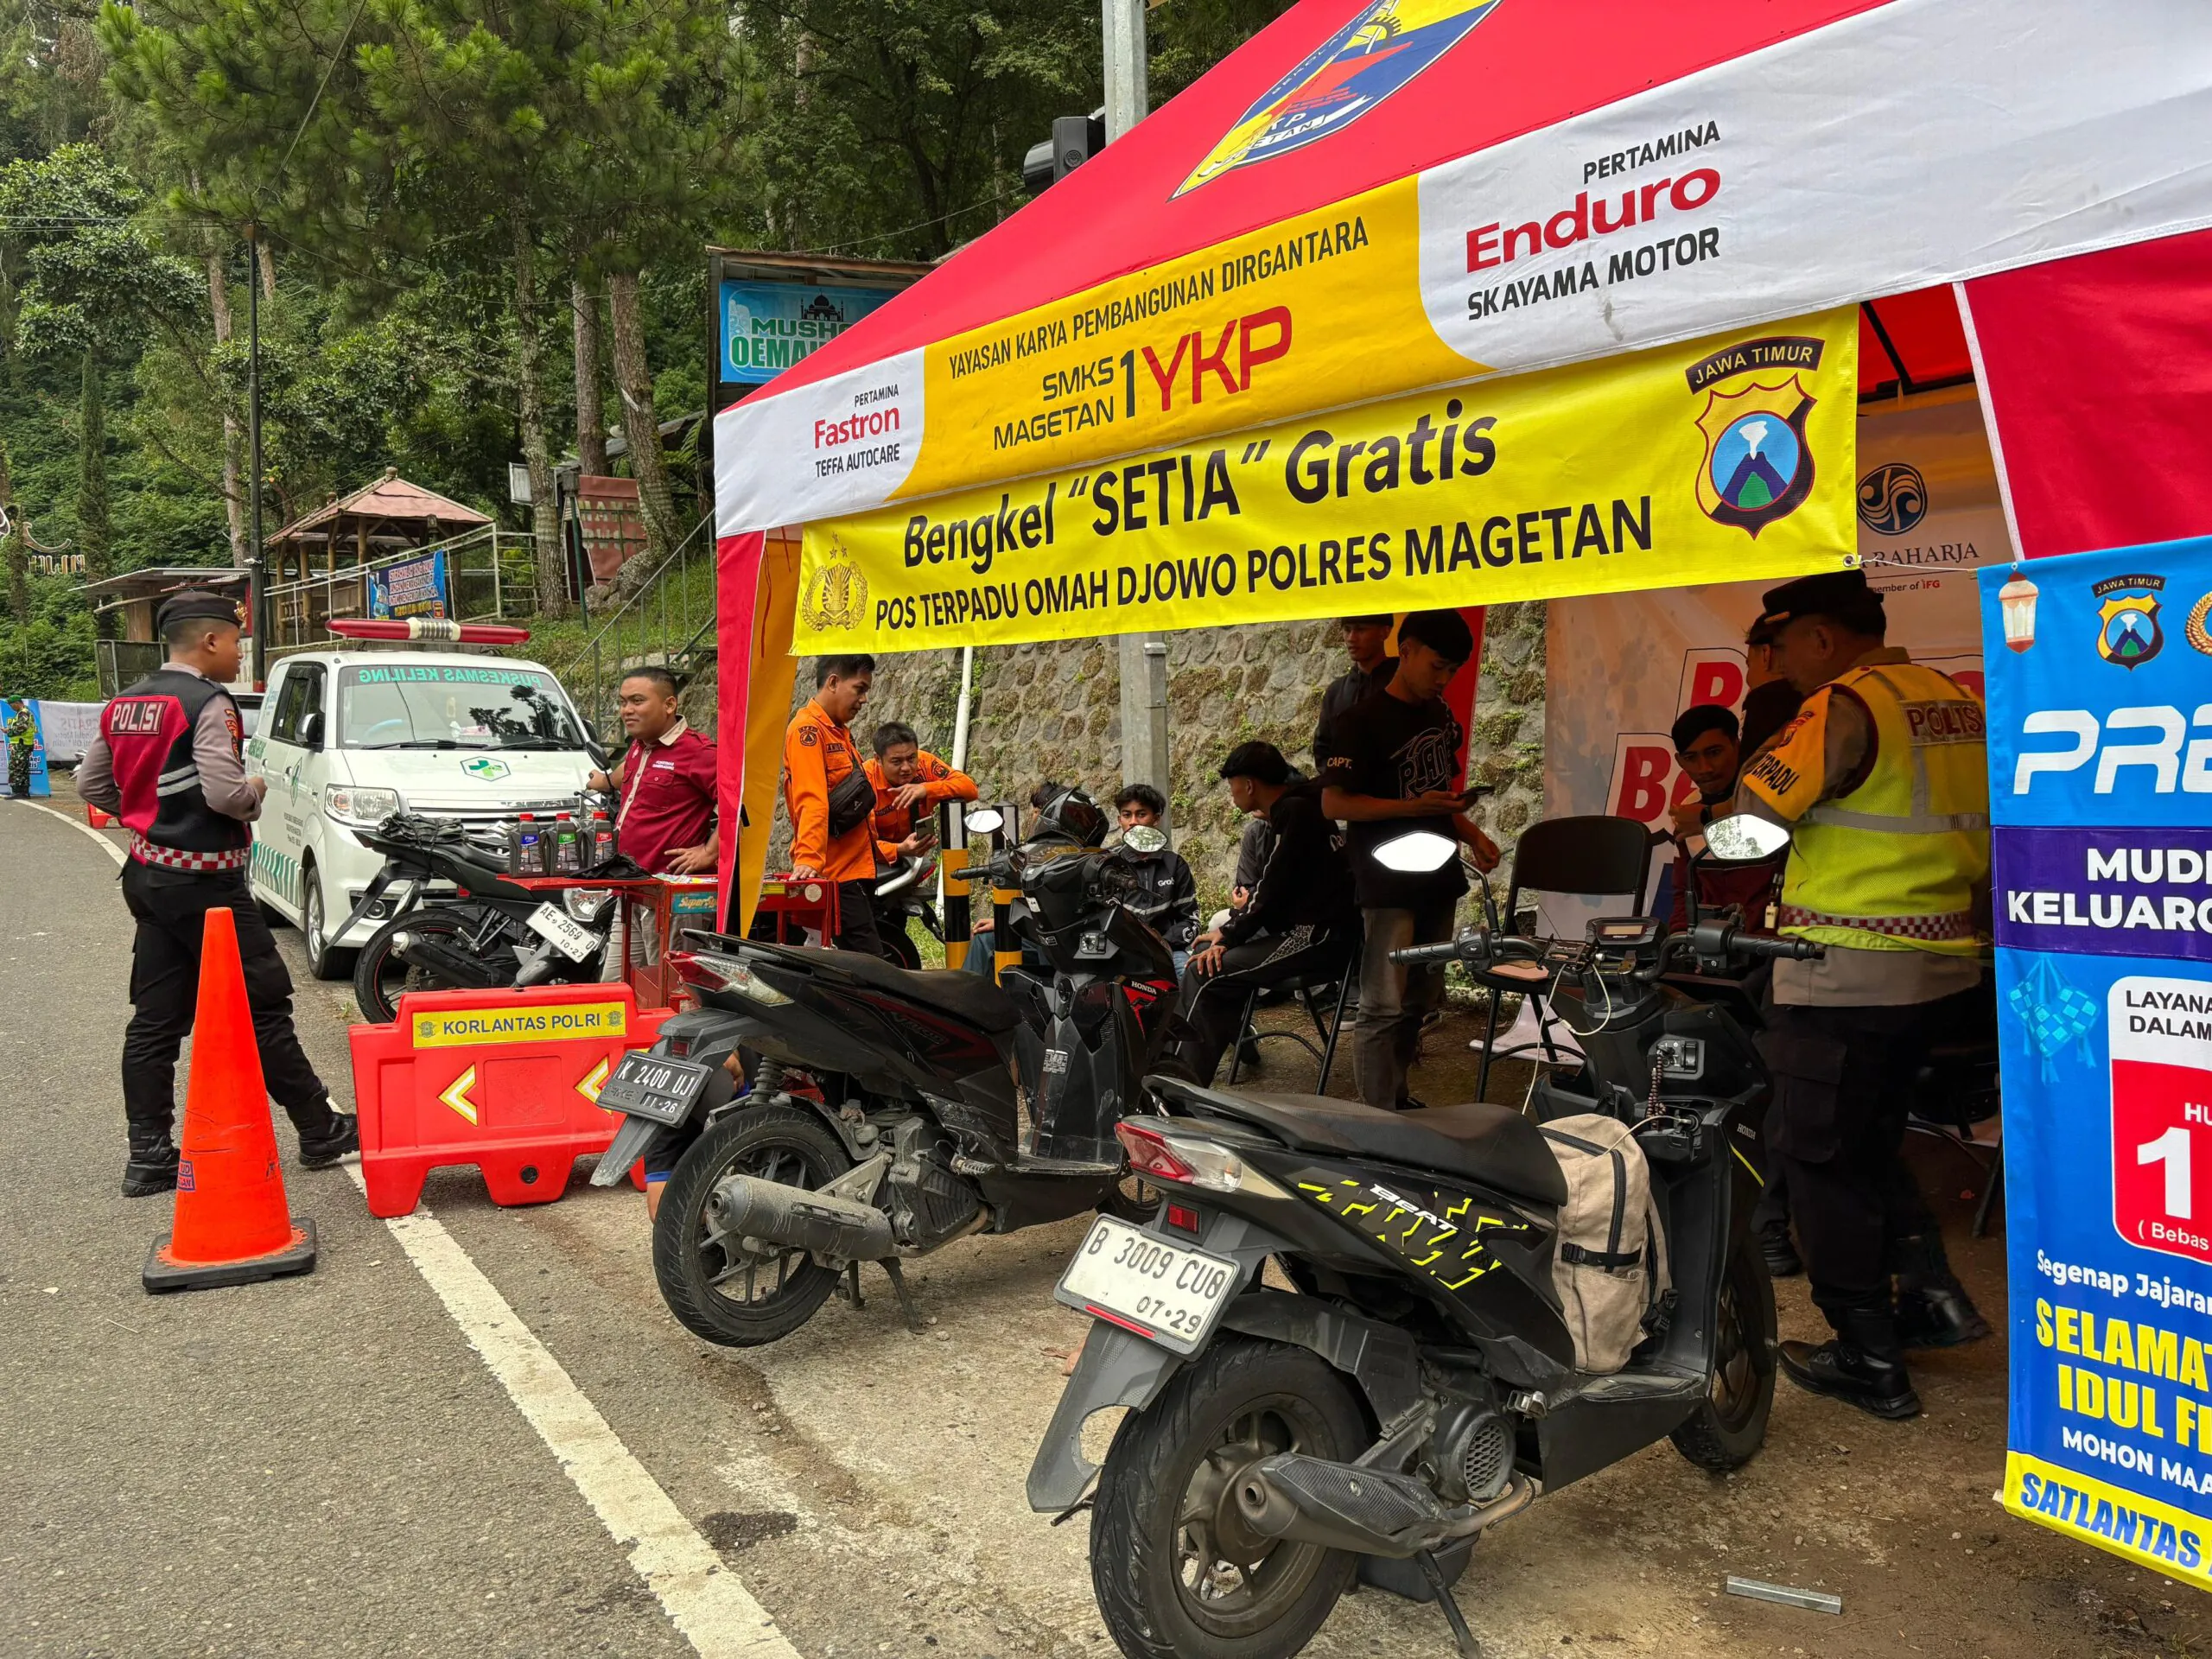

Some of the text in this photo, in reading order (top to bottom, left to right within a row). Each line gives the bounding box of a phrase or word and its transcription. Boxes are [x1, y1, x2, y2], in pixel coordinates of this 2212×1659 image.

[1583, 120, 1720, 185] PERTAMINA
[1466, 168, 1721, 274] Enduro
[1467, 226, 1720, 321] SKAYAMA MOTOR
[949, 216, 1369, 379] YAYASAN KARYA PEMBANGUNAN DIRGANTARA
[731, 336, 823, 369] OEMA
[1120, 306, 1293, 418] 1 YKP
[1695, 346, 1814, 385] JAWA TIMUR
[855, 384, 899, 407] PERTAMINA
[1042, 356, 1114, 402] SMKS
[815, 407, 899, 448] Fastron
[994, 396, 1114, 450] MAGETAN
[816, 443, 900, 477] TEFFA AUTOCARE
[904, 482, 1058, 575] Bengkel
[1285, 398, 1497, 505] Gratis
[875, 495, 1652, 631] POS TERPADU OMAH DJOWO POLRES MAGETAN
[1872, 543, 1980, 567] RAHARJA
[1909, 582, 1920, 590] of
[2097, 577, 2161, 594] JAWA TIMUR
[111, 702, 162, 732] POLISI
[540, 906, 556, 920] AE
[1131, 981, 1157, 995] HONDA
[442, 1013, 601, 1035] KORLANTAS POLRI
[618, 1061, 634, 1080] K
[633, 1065, 671, 1089] 2400
[1737, 1123, 1756, 1141] HONDA
[2137, 1126, 2191, 1220] 1
[2152, 1222, 2209, 1251] Bebas
[1088, 1226, 1227, 1300] B 3009 CUB
[2037, 1249, 2129, 1296] Segenap
[2057, 1363, 2164, 1439] IDUL
[2063, 1426, 2153, 1477] MOHON
[2020, 1472, 2201, 1568] SATLANTAS
